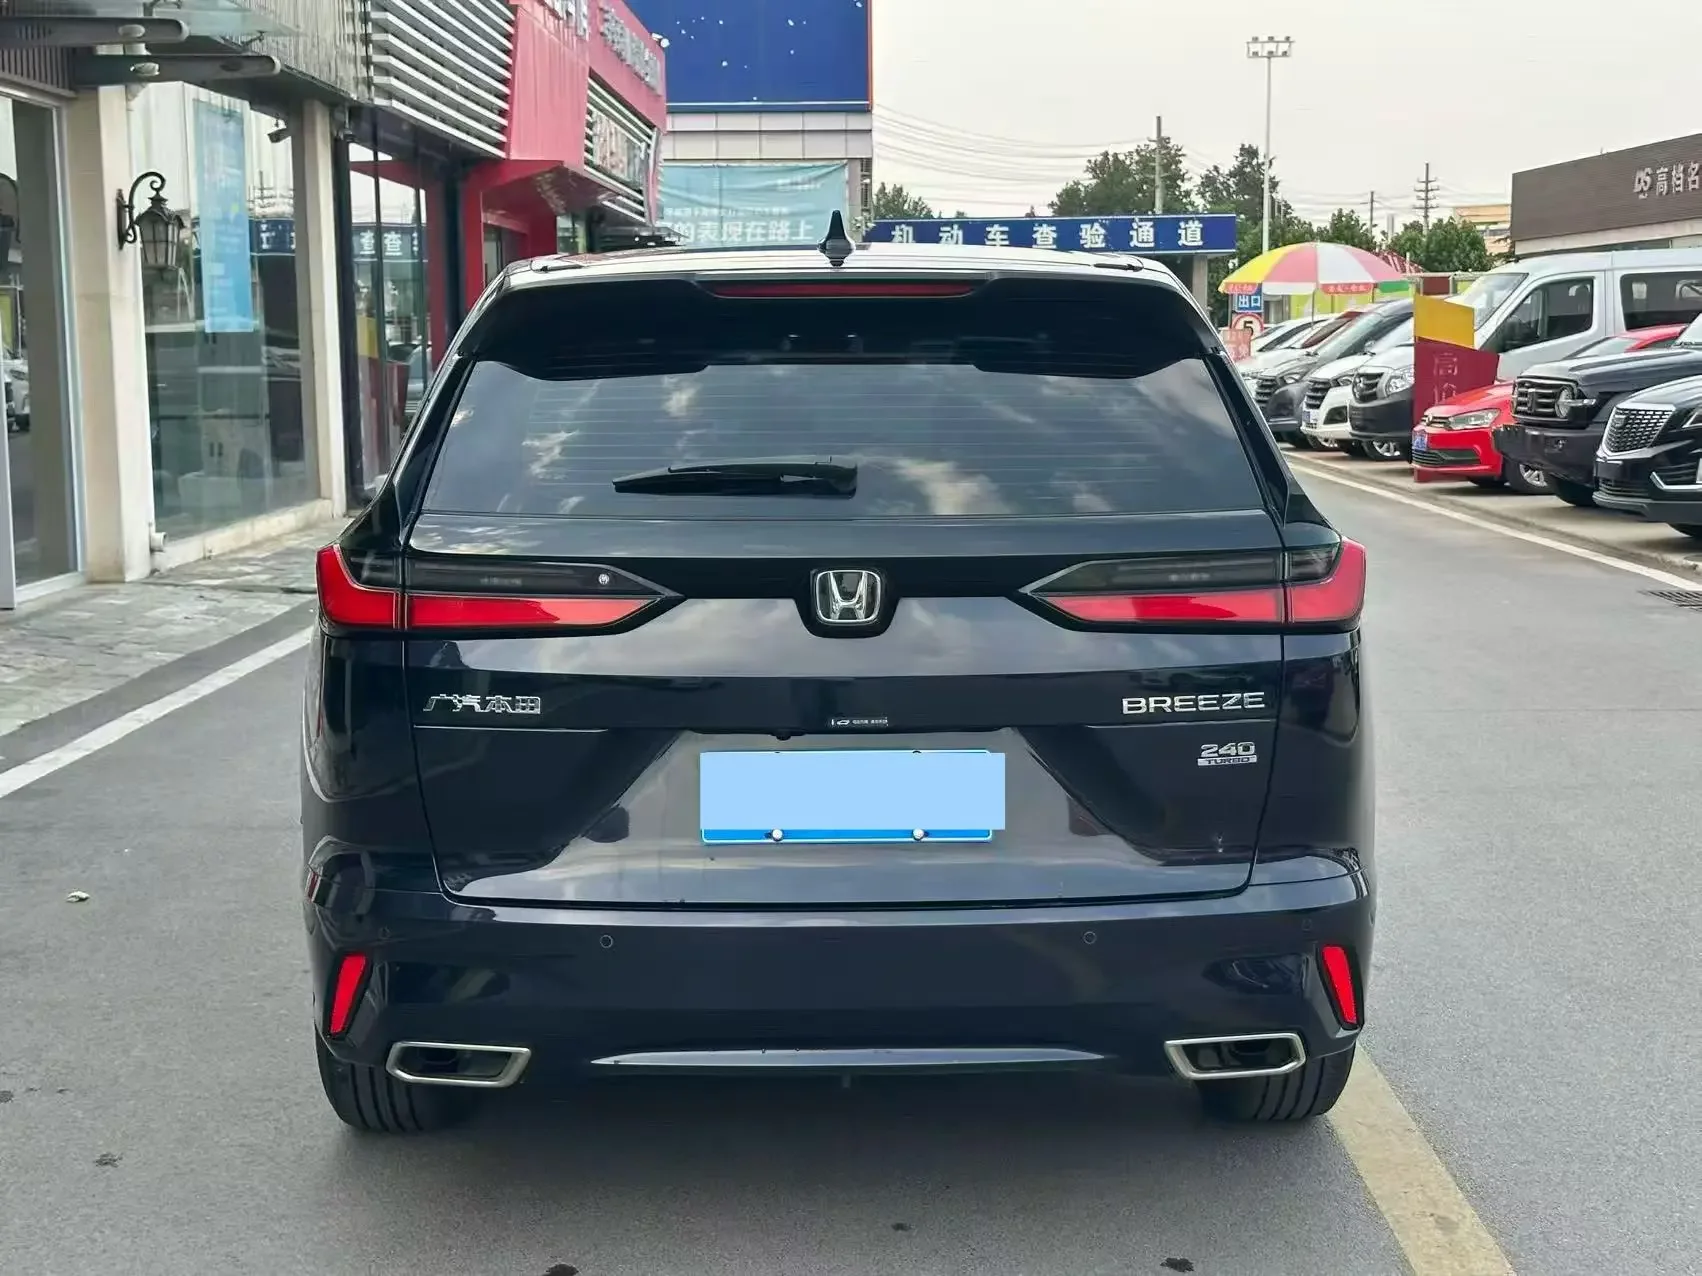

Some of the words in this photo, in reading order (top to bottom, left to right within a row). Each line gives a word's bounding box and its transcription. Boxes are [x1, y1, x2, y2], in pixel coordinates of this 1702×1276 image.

[891, 220, 1203, 249] 机动车查验通道
[1238, 295, 1261, 308] 出口
[1243, 320, 1254, 336] 5
[423, 694, 541, 714] 广汽本田
[1122, 691, 1266, 714] BREEZE
[1200, 741, 1256, 757] 240
[1204, 756, 1252, 765] TURBO
